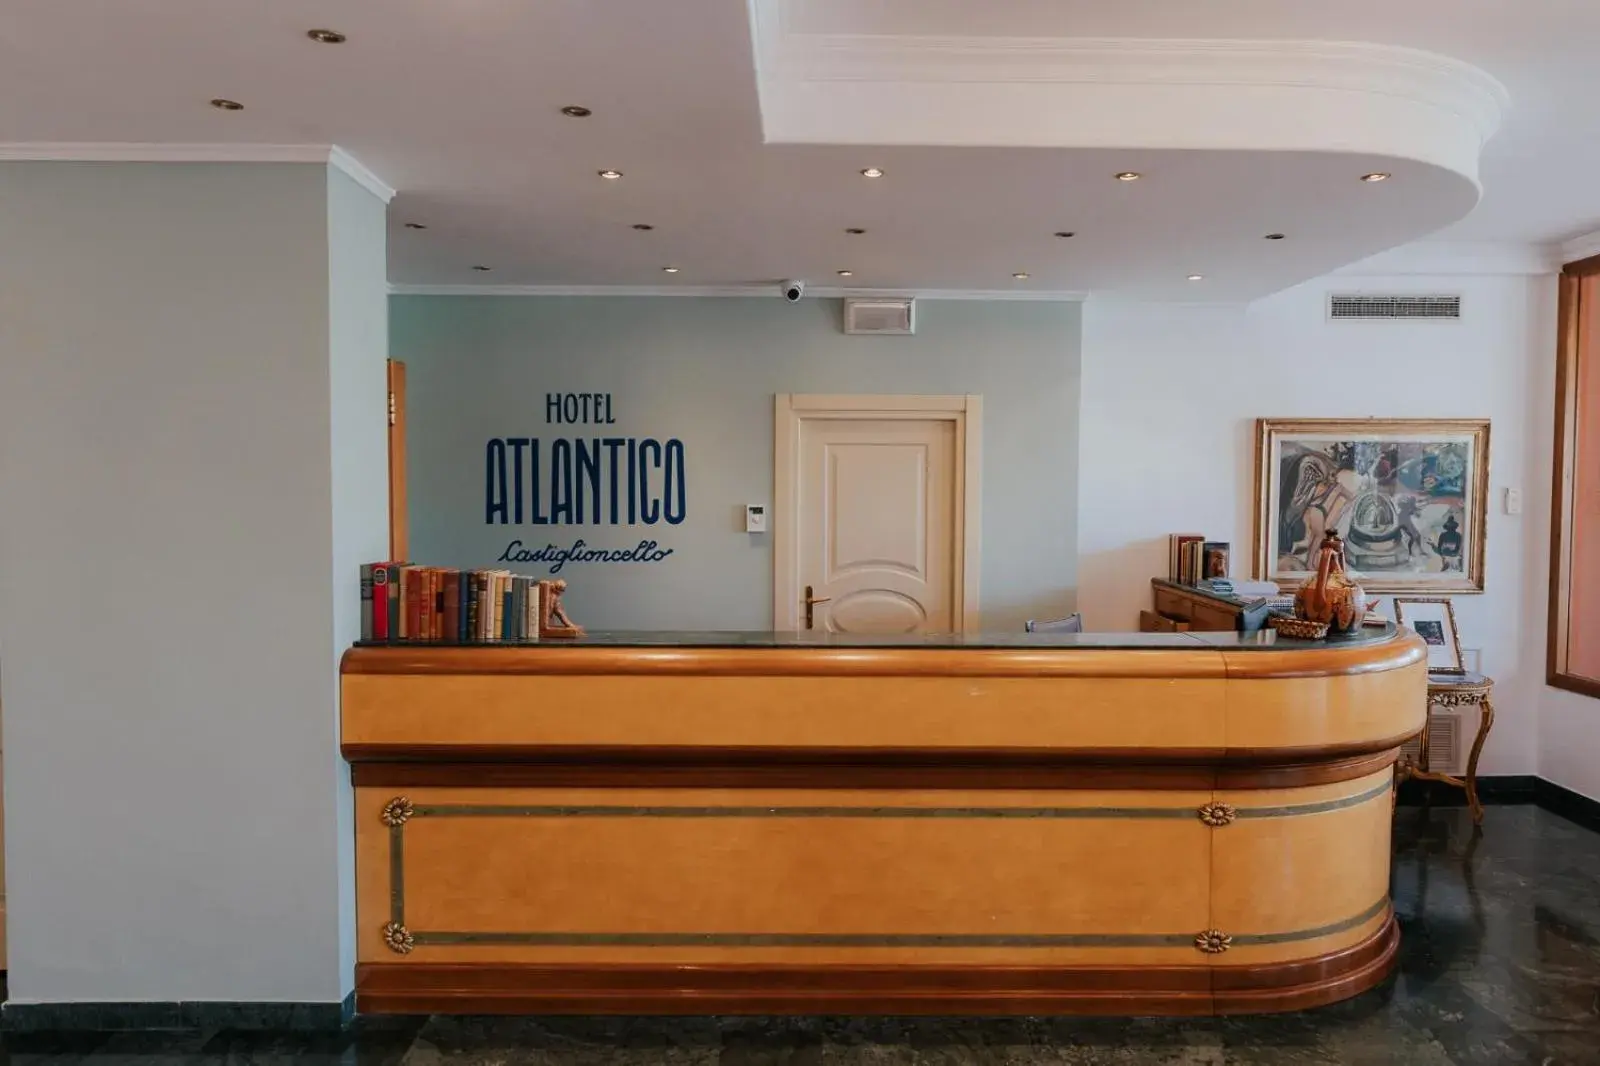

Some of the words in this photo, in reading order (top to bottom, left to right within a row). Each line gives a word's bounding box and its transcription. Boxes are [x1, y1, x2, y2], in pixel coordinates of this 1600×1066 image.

[546, 393, 615, 423] HOTEL
[486, 438, 686, 525] ATLANTICO
[498, 539, 673, 574] Castiglioncello
